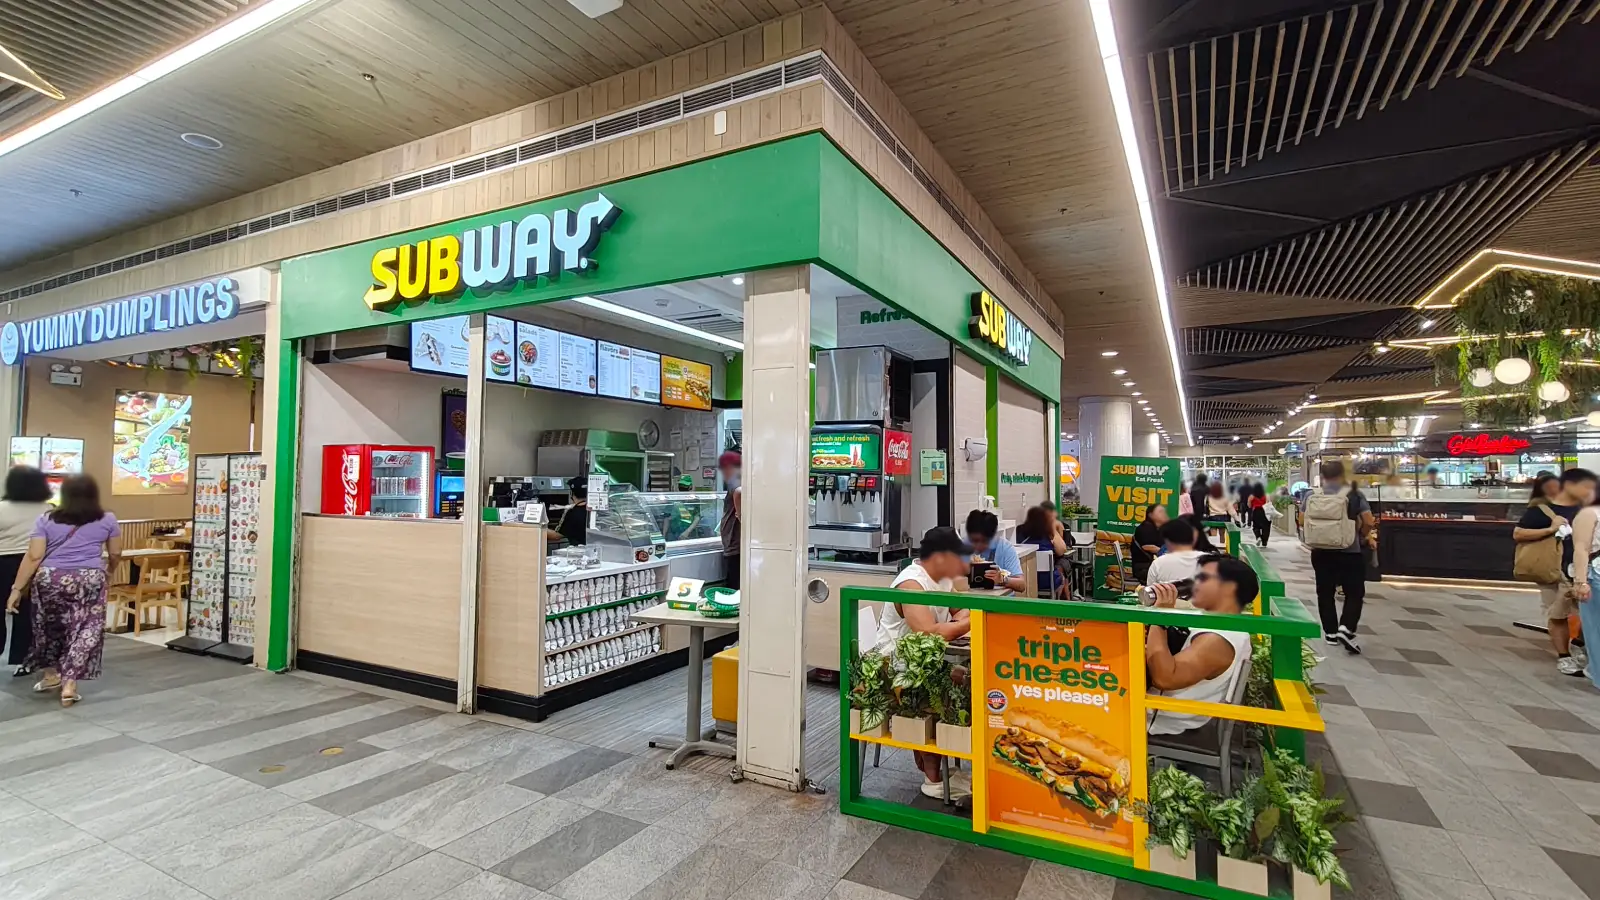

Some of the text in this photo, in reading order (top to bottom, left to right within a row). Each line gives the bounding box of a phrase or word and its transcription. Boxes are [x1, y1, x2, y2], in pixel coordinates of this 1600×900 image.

[363, 192, 614, 310] SUBWAY
[20, 278, 238, 354] YUMMY DUMPLINGS
[978, 290, 1032, 366] SUBWAY
[1110, 464, 1169, 476] SUBWAY
[1106, 485, 1173, 505] VISIT
[1406, 511, 1448, 519] ITALIAN
[1017, 634, 1102, 665] triple
[1012, 684, 1110, 713] yes please!
